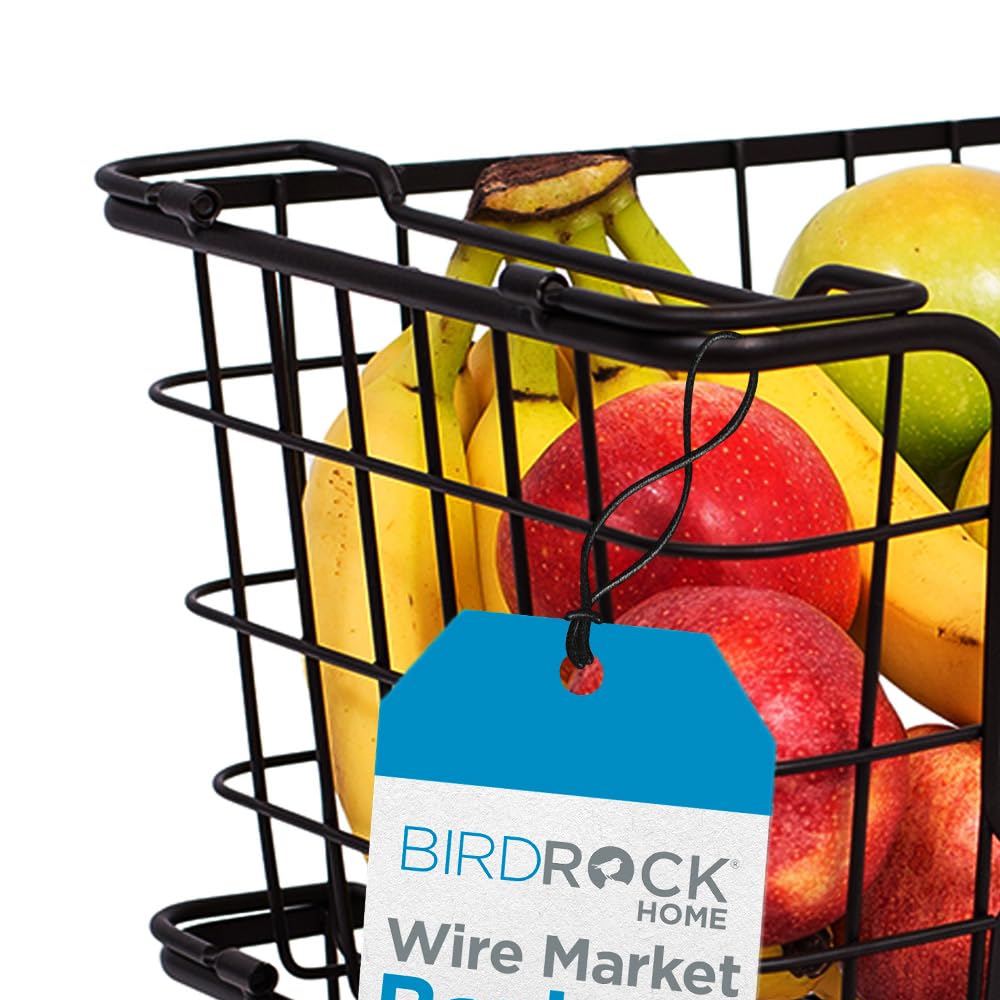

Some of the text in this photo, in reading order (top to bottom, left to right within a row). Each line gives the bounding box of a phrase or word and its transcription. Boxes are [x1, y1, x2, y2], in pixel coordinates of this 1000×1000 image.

[636, 900, 728, 930] HOME
[387, 917, 741, 997] Wire Market
